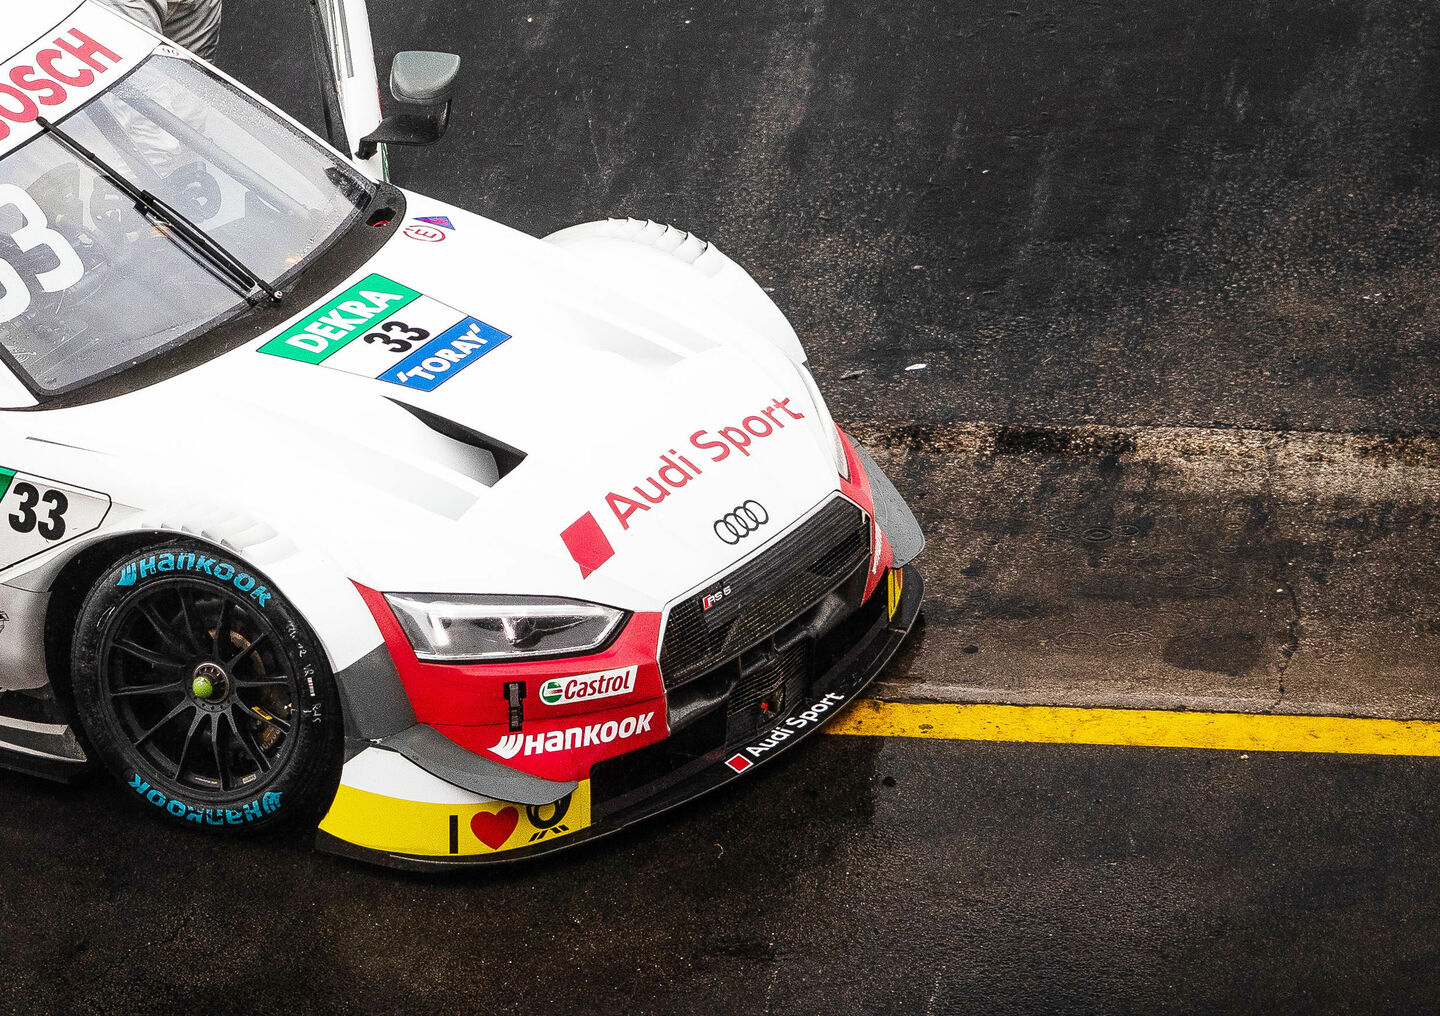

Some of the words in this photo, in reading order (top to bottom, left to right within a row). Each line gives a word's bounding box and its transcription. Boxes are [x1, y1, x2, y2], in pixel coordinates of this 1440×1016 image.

[285, 283, 403, 355] DEKRA
[363, 320, 431, 354] 33
[605, 448, 704, 530] Audi
[690, 396, 805, 465] Sport
[8, 482, 69, 541] 33
[564, 670, 630, 700] Castrol
[746, 727, 795, 757] Audi
[785, 692, 845, 728] Sport
